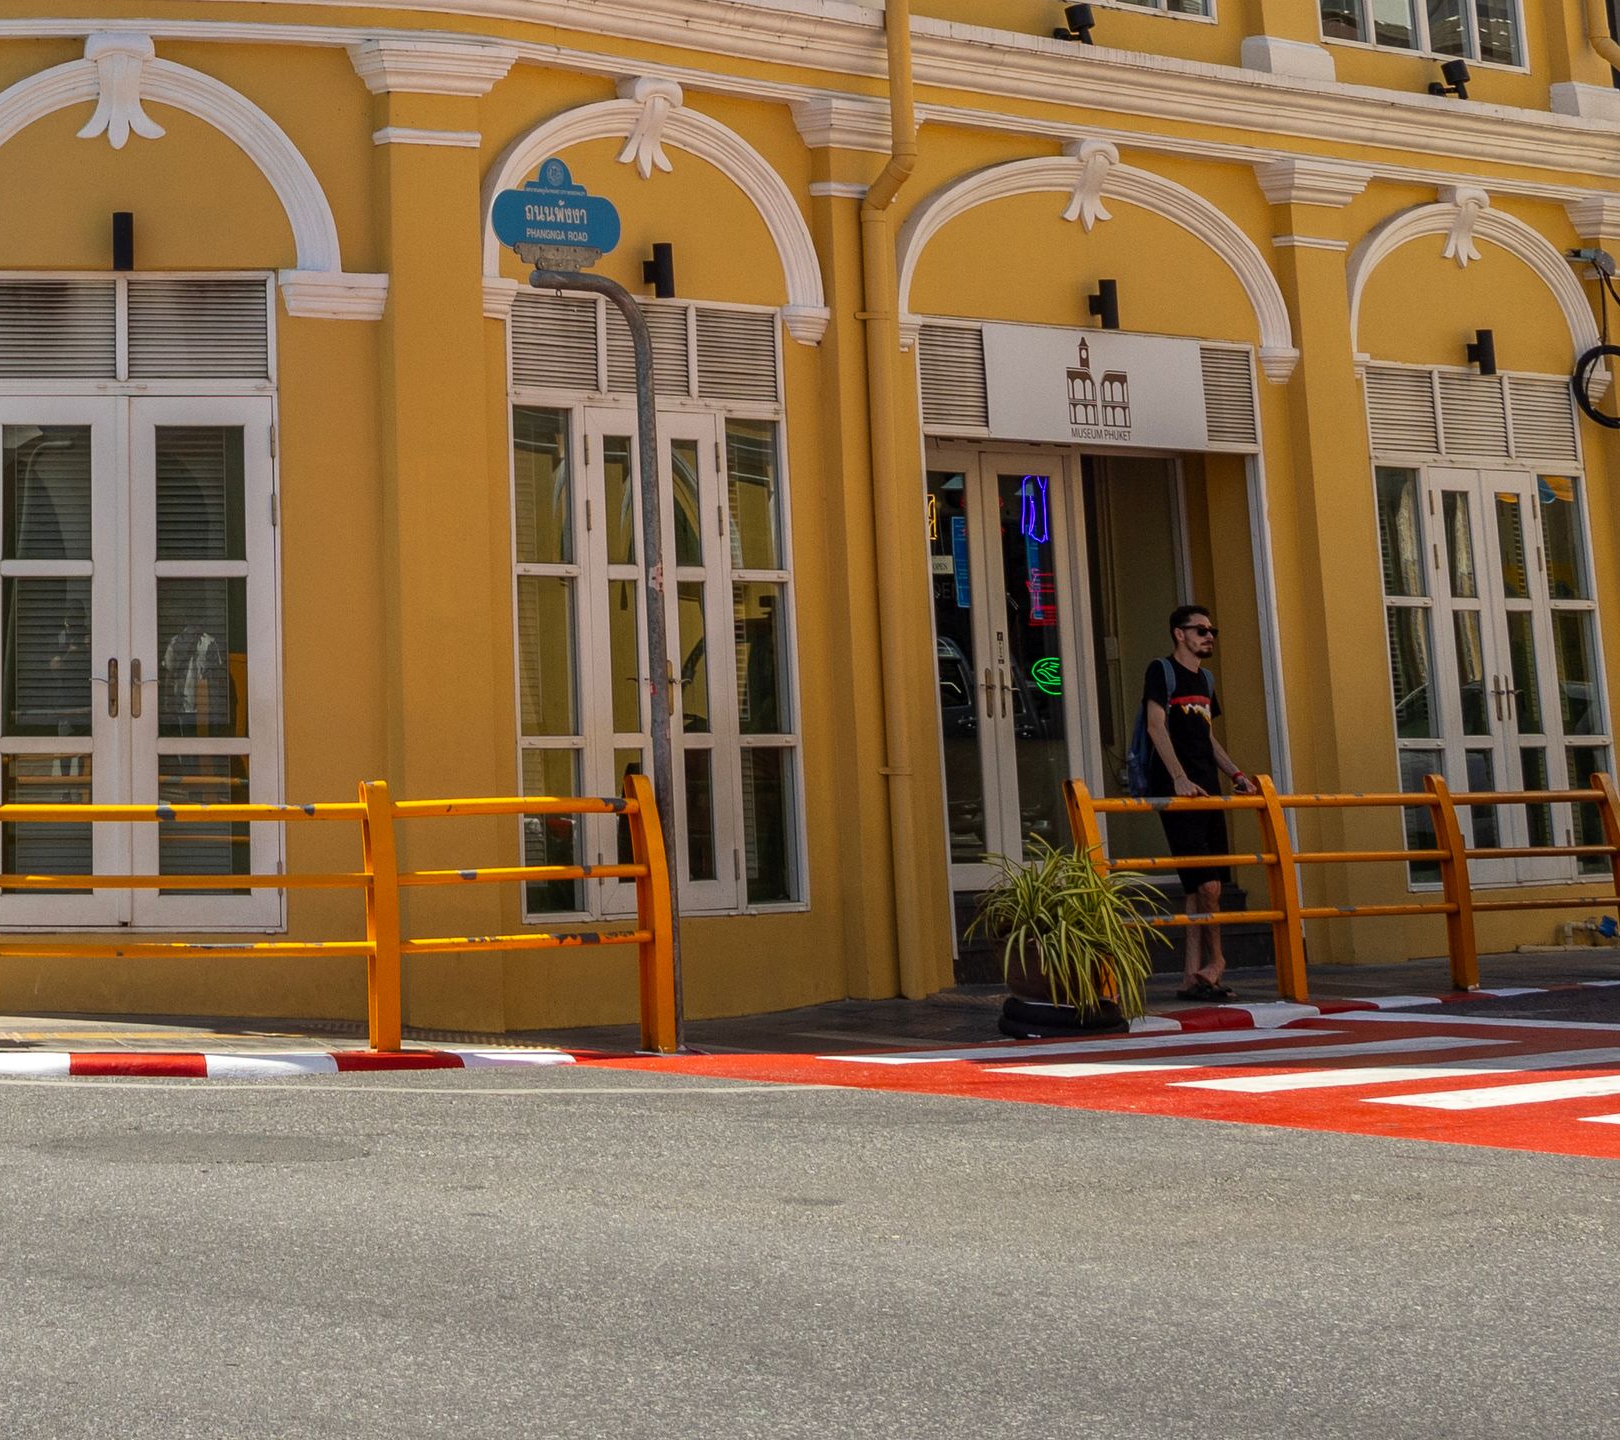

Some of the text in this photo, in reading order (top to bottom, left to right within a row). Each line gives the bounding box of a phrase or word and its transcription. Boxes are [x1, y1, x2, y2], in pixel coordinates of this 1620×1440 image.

[525, 200, 587, 225] ถนนพังงา
[526, 228, 588, 242] PHANGNGA ROAD
[1071, 427, 1131, 441] MUSEUM PHUKET
